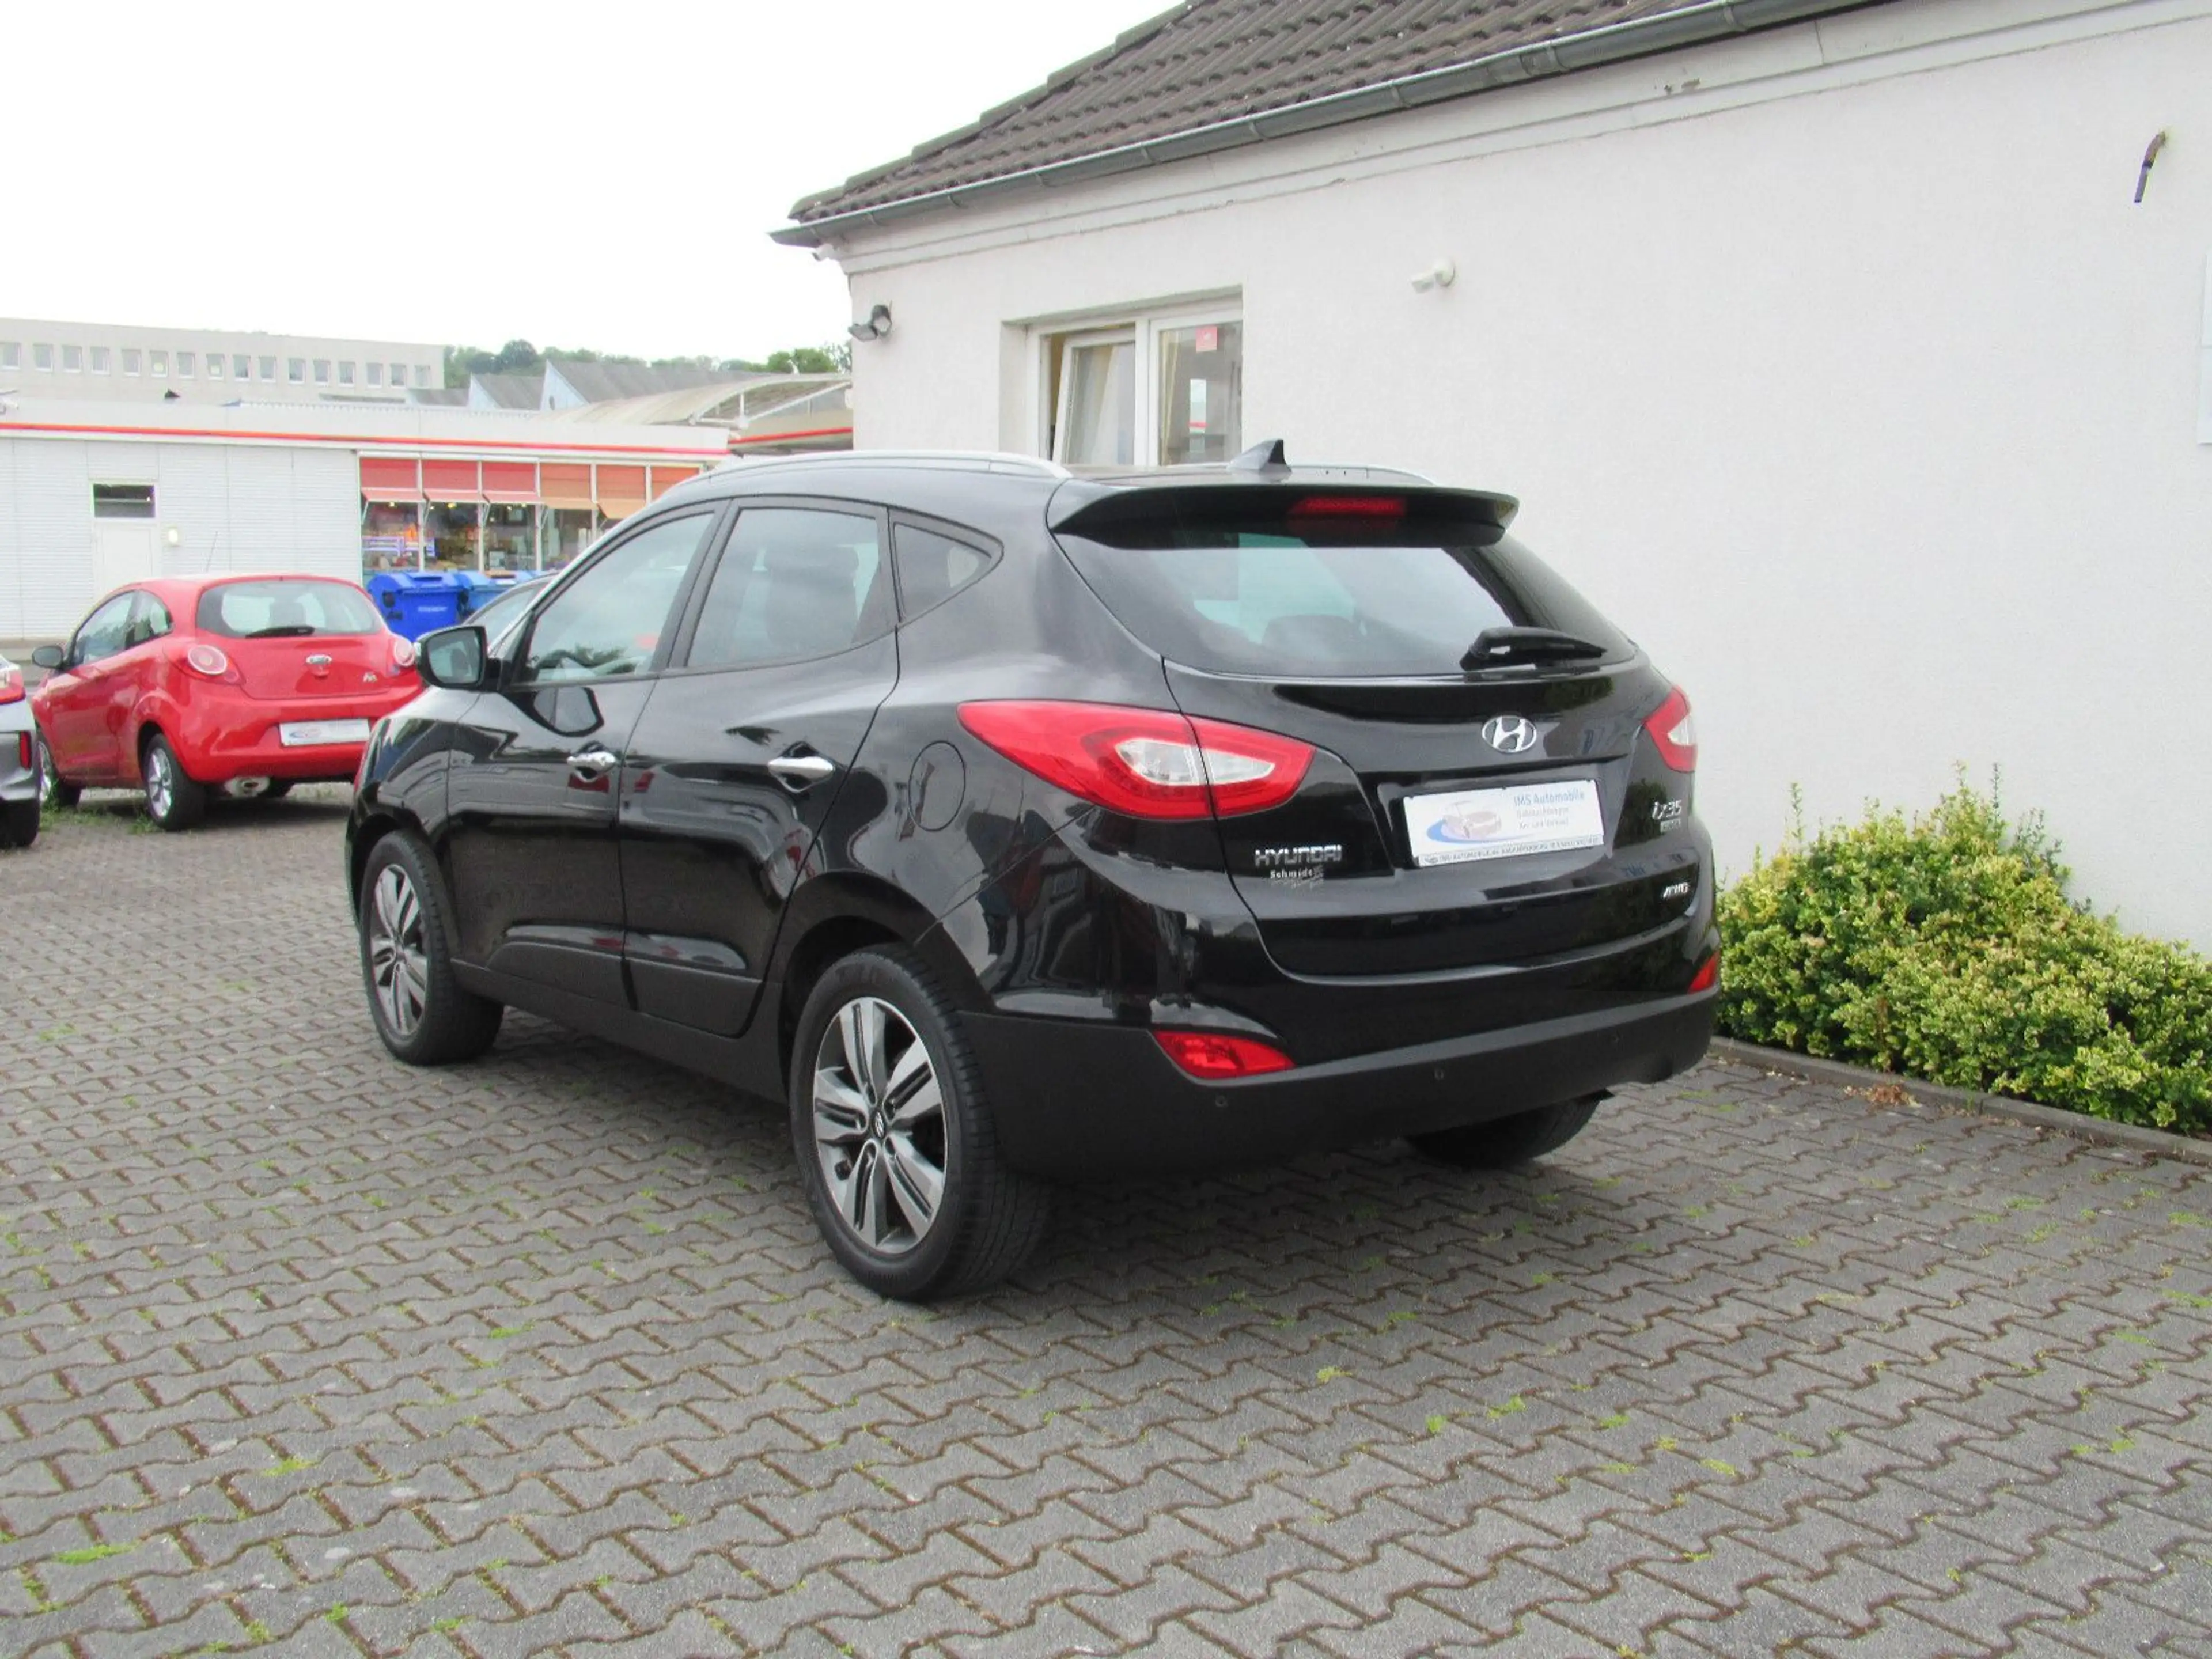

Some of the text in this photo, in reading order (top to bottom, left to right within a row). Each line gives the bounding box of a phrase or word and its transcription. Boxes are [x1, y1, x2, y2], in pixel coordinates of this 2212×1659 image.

[1514, 788, 1585, 807] IMS Automobile
[1255, 844, 1342, 868] HYUNDAI
[1270, 866, 1313, 878] Schmidt
